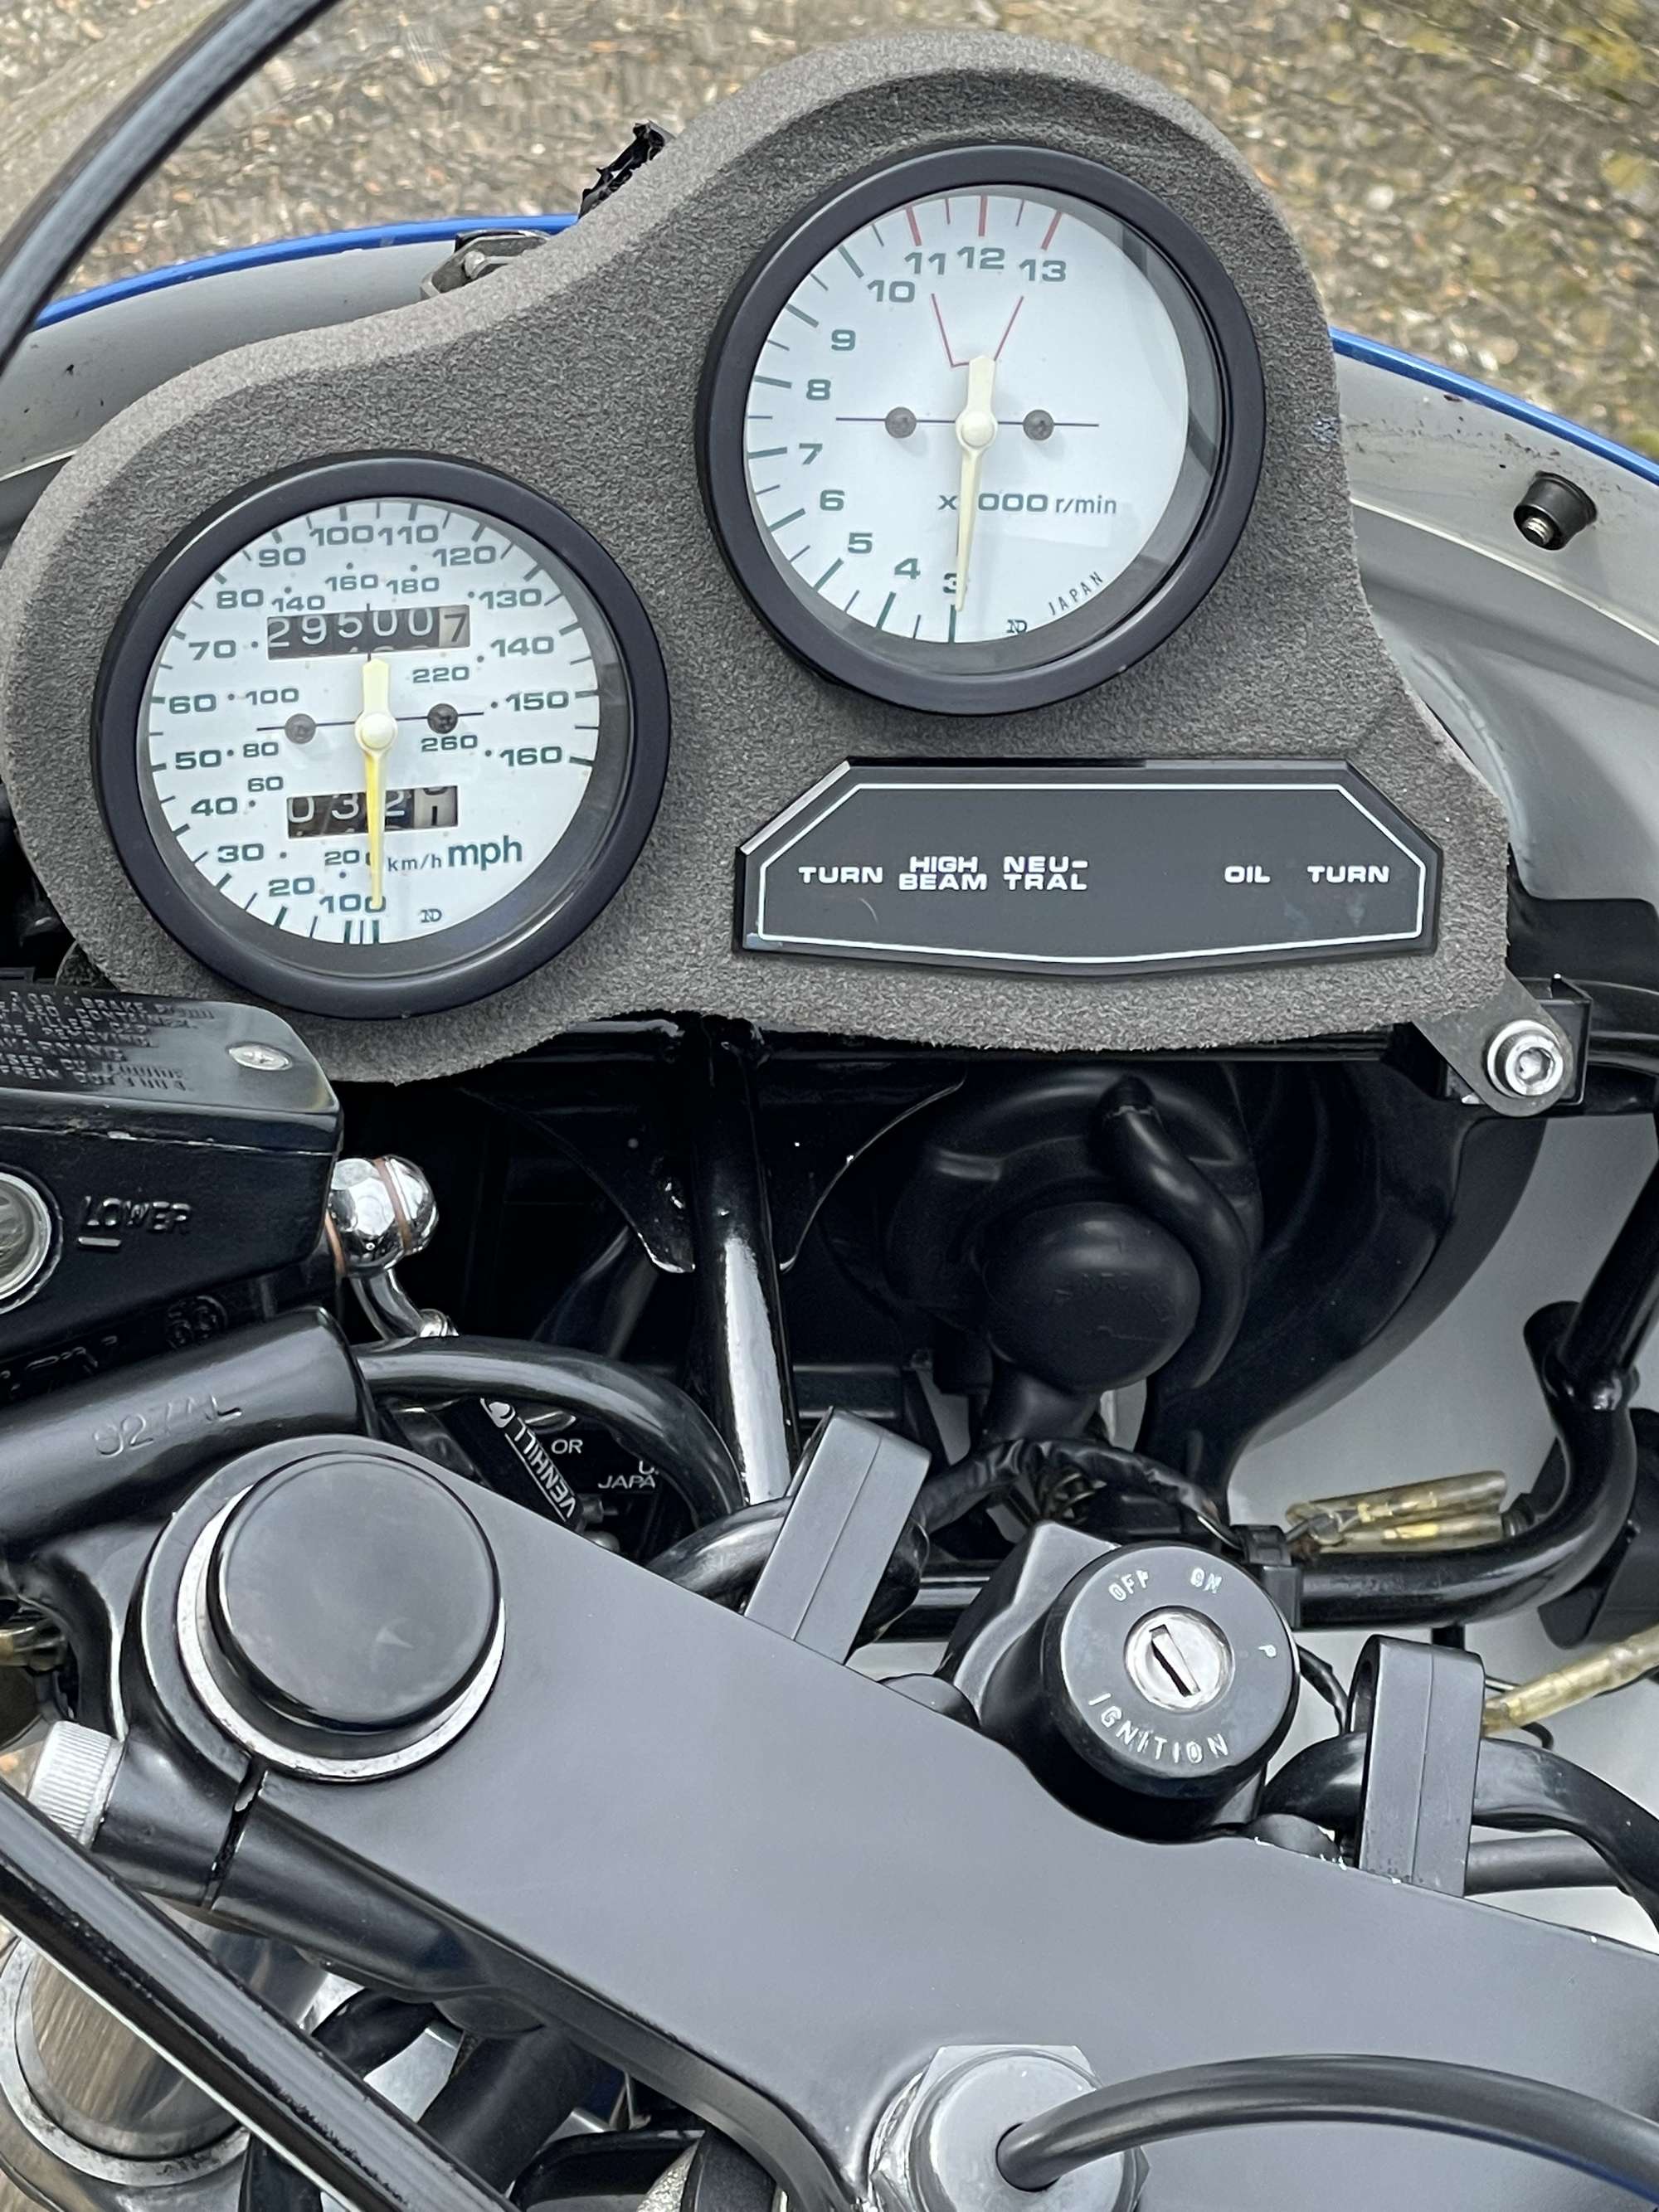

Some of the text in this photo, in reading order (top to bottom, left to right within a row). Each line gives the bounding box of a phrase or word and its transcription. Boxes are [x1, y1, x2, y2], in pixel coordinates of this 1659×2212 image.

[904, 251, 946, 275] 11
[957, 246, 1005, 270] 12
[1019, 260, 1067, 282] 13
[867, 280, 915, 303] 10
[831, 329, 857, 352] 9
[805, 379, 831, 401] 8
[799, 442, 823, 464] 7
[820, 489, 845, 512] 6
[938, 493, 1117, 514] x000 r/min
[309, 525, 374, 547] 100
[377, 523, 440, 545] 110
[847, 532, 873, 554] 5
[258, 547, 306, 567] 90
[433, 544, 496, 566] 120
[894, 557, 921, 580] 4
[324, 573, 379, 591] 160
[386, 576, 440, 596] 180
[216, 589, 264, 608] 80
[271, 594, 326, 613] 140
[479, 587, 542, 610] 130
[1048, 571, 1104, 615] JAPAN
[267, 607, 467, 648] 295007
[188, 639, 236, 660] 70
[490, 635, 555, 656] 140
[411, 666, 470, 683] 220
[168, 693, 217, 713] 60
[246, 687, 299, 705] 100
[505, 690, 569, 711] 150
[242, 741, 280, 759] 80
[421, 734, 479, 752] 260
[174, 748, 222, 770] 50
[499, 746, 563, 766] 160
[247, 775, 284, 792] 60
[190, 797, 238, 816] 40
[217, 843, 265, 863] 30
[387, 853, 442, 872] km/h
[448, 835, 523, 871] mph
[798, 864, 883, 884] TURN
[909, 855, 978, 873] HIGH
[1003, 855, 1088, 873] NEU-
[1224, 864, 1270, 883] OIL
[1307, 864, 1390, 883] TURN
[268, 878, 315, 897] 20
[898, 873, 987, 891] BEAM
[1003, 873, 1087, 891] TRAL
[84, 1195, 192, 1235] LOWER
[513, 1417, 577, 1519] VENHILL
[1108, 1569, 1149, 1602] OFF
[1190, 1567, 1224, 1594] ON
[1258, 1644, 1277, 1658] P
[1088, 1692, 1228, 1764] IGNITION
